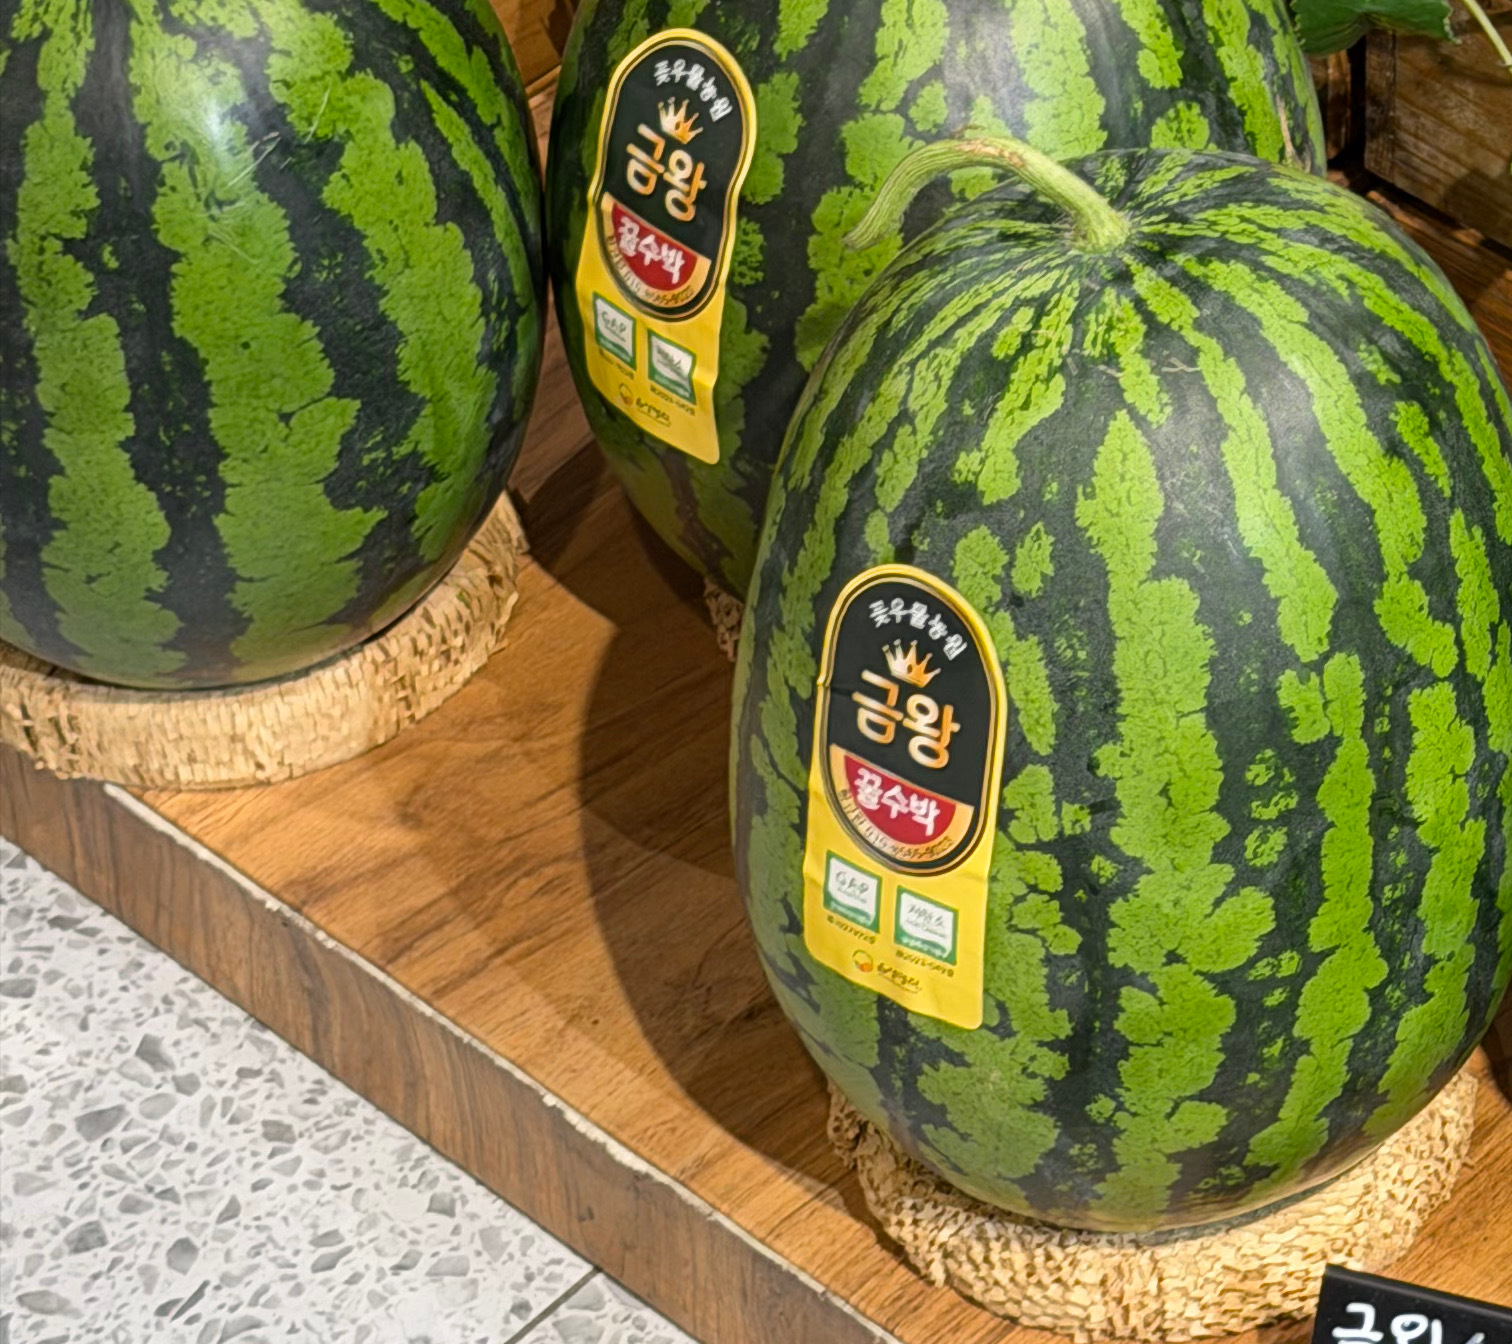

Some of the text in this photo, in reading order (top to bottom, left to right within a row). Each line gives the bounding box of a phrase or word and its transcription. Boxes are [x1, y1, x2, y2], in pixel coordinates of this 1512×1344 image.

[626, 123, 707, 222] 금왕
[618, 215, 686, 285] 꿀수박
[852, 670, 961, 769] 금왕
[854, 767, 941, 836] 꿀수박
